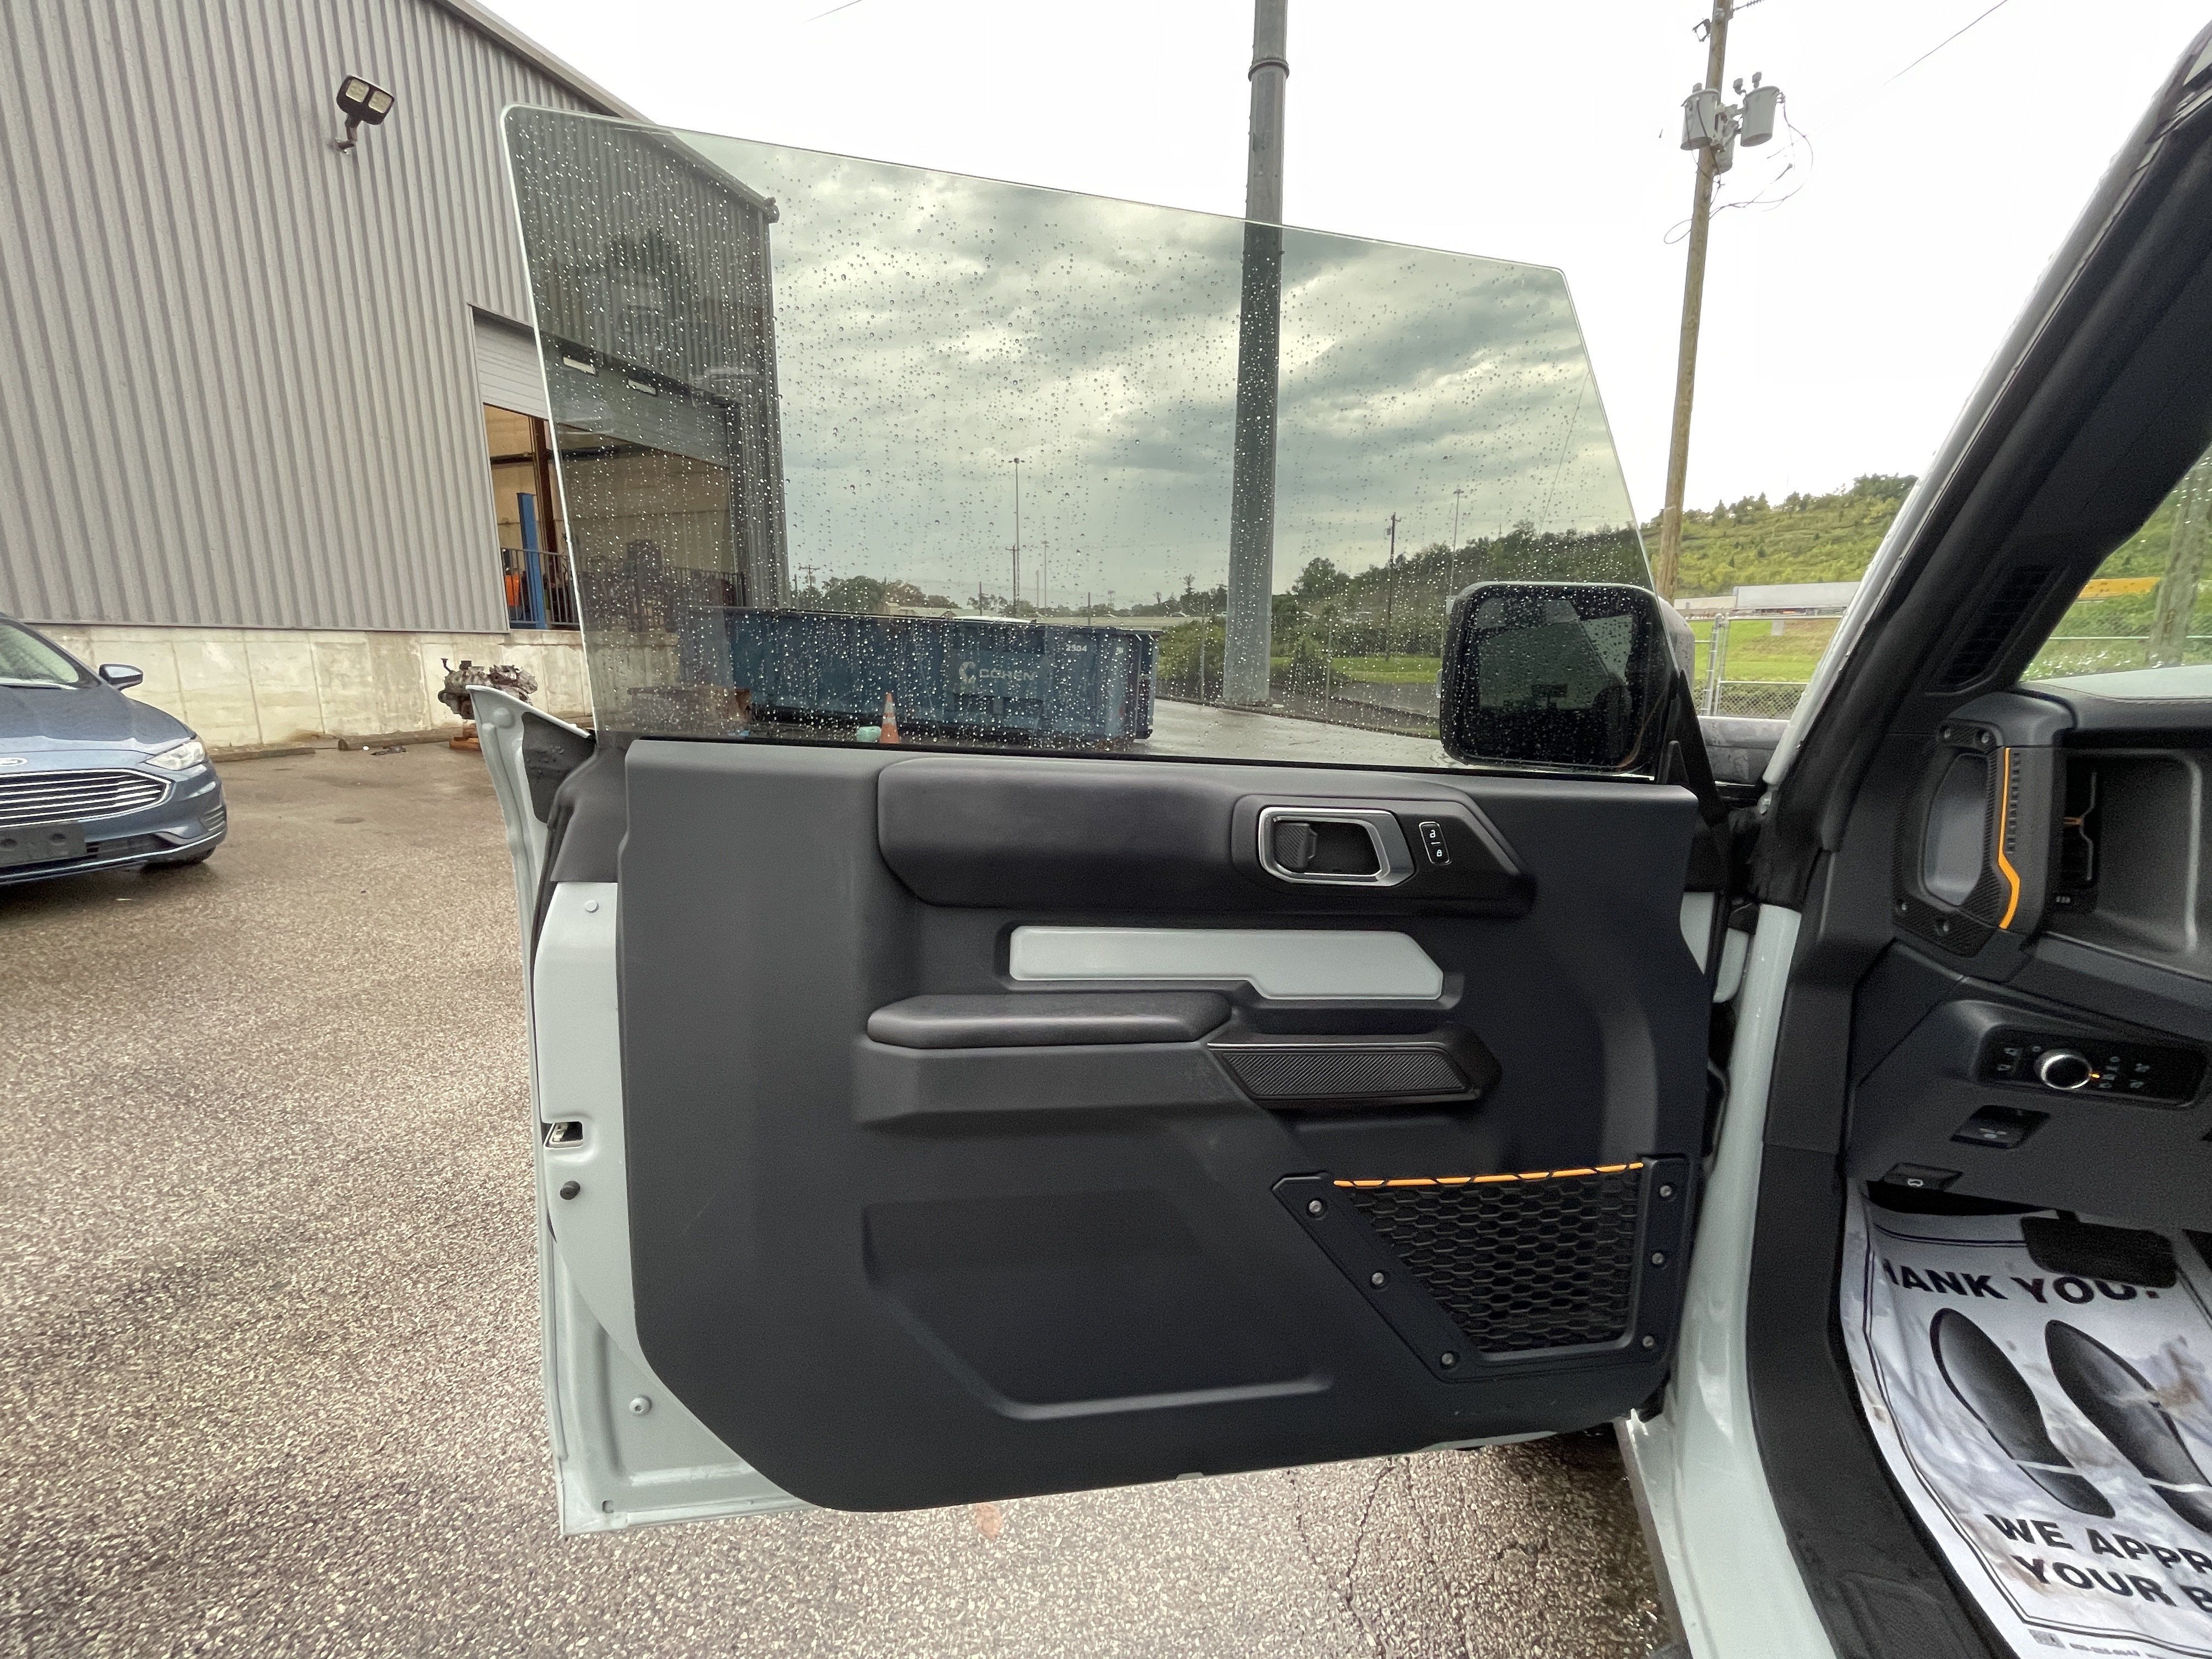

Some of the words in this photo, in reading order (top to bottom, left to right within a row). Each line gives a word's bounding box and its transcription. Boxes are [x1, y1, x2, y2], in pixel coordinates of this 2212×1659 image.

[979, 668, 1036, 681] COHEN
[2009, 1277, 2160, 1304] YOU
[1984, 1514, 2075, 1550] WE
[2011, 1555, 2176, 1607] YOUR
